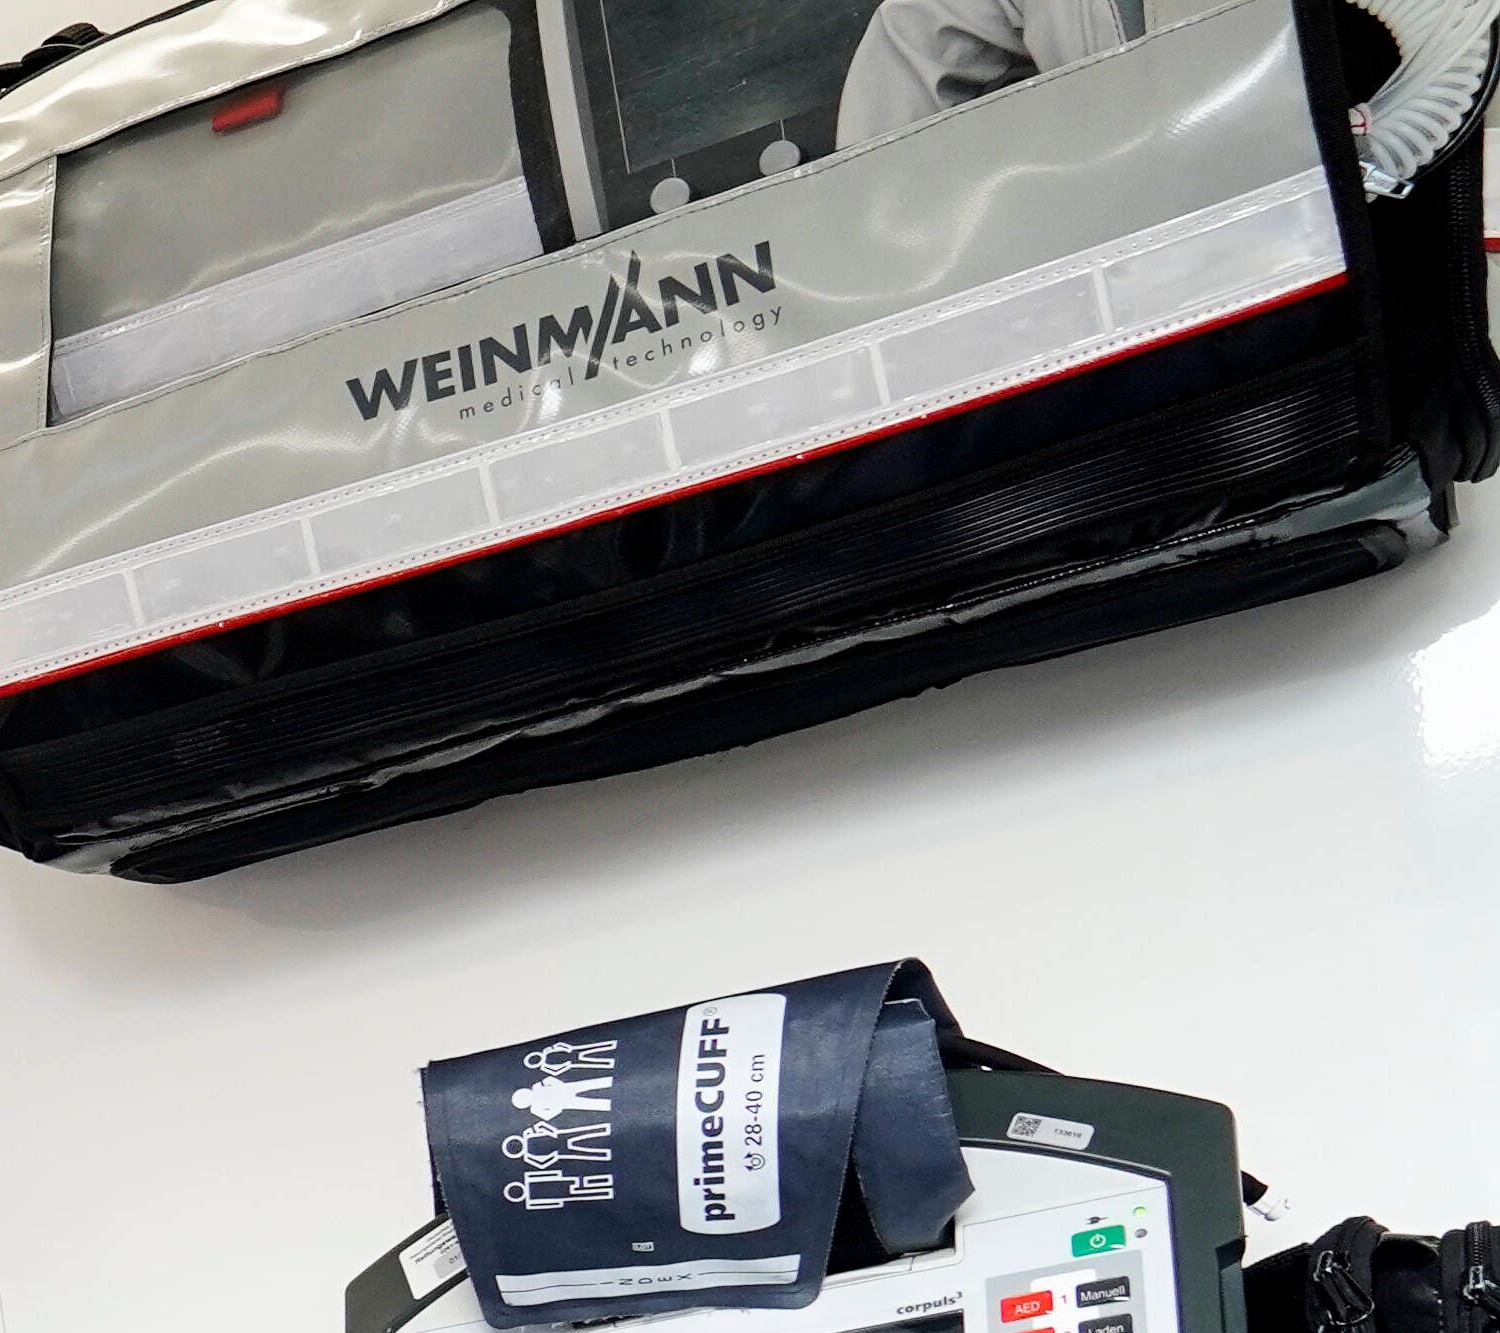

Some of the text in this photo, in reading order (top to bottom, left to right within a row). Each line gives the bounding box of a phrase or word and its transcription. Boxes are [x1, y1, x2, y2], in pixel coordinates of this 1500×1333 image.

[345, 240, 776, 421] WEINMANN
[459, 305, 783, 421] medical technology
[693, 1018, 736, 1221] primeCUFF
[744, 1054, 765, 1147] 28-40 cm
[1014, 1285, 1126, 1315] AED 1 Manuell
